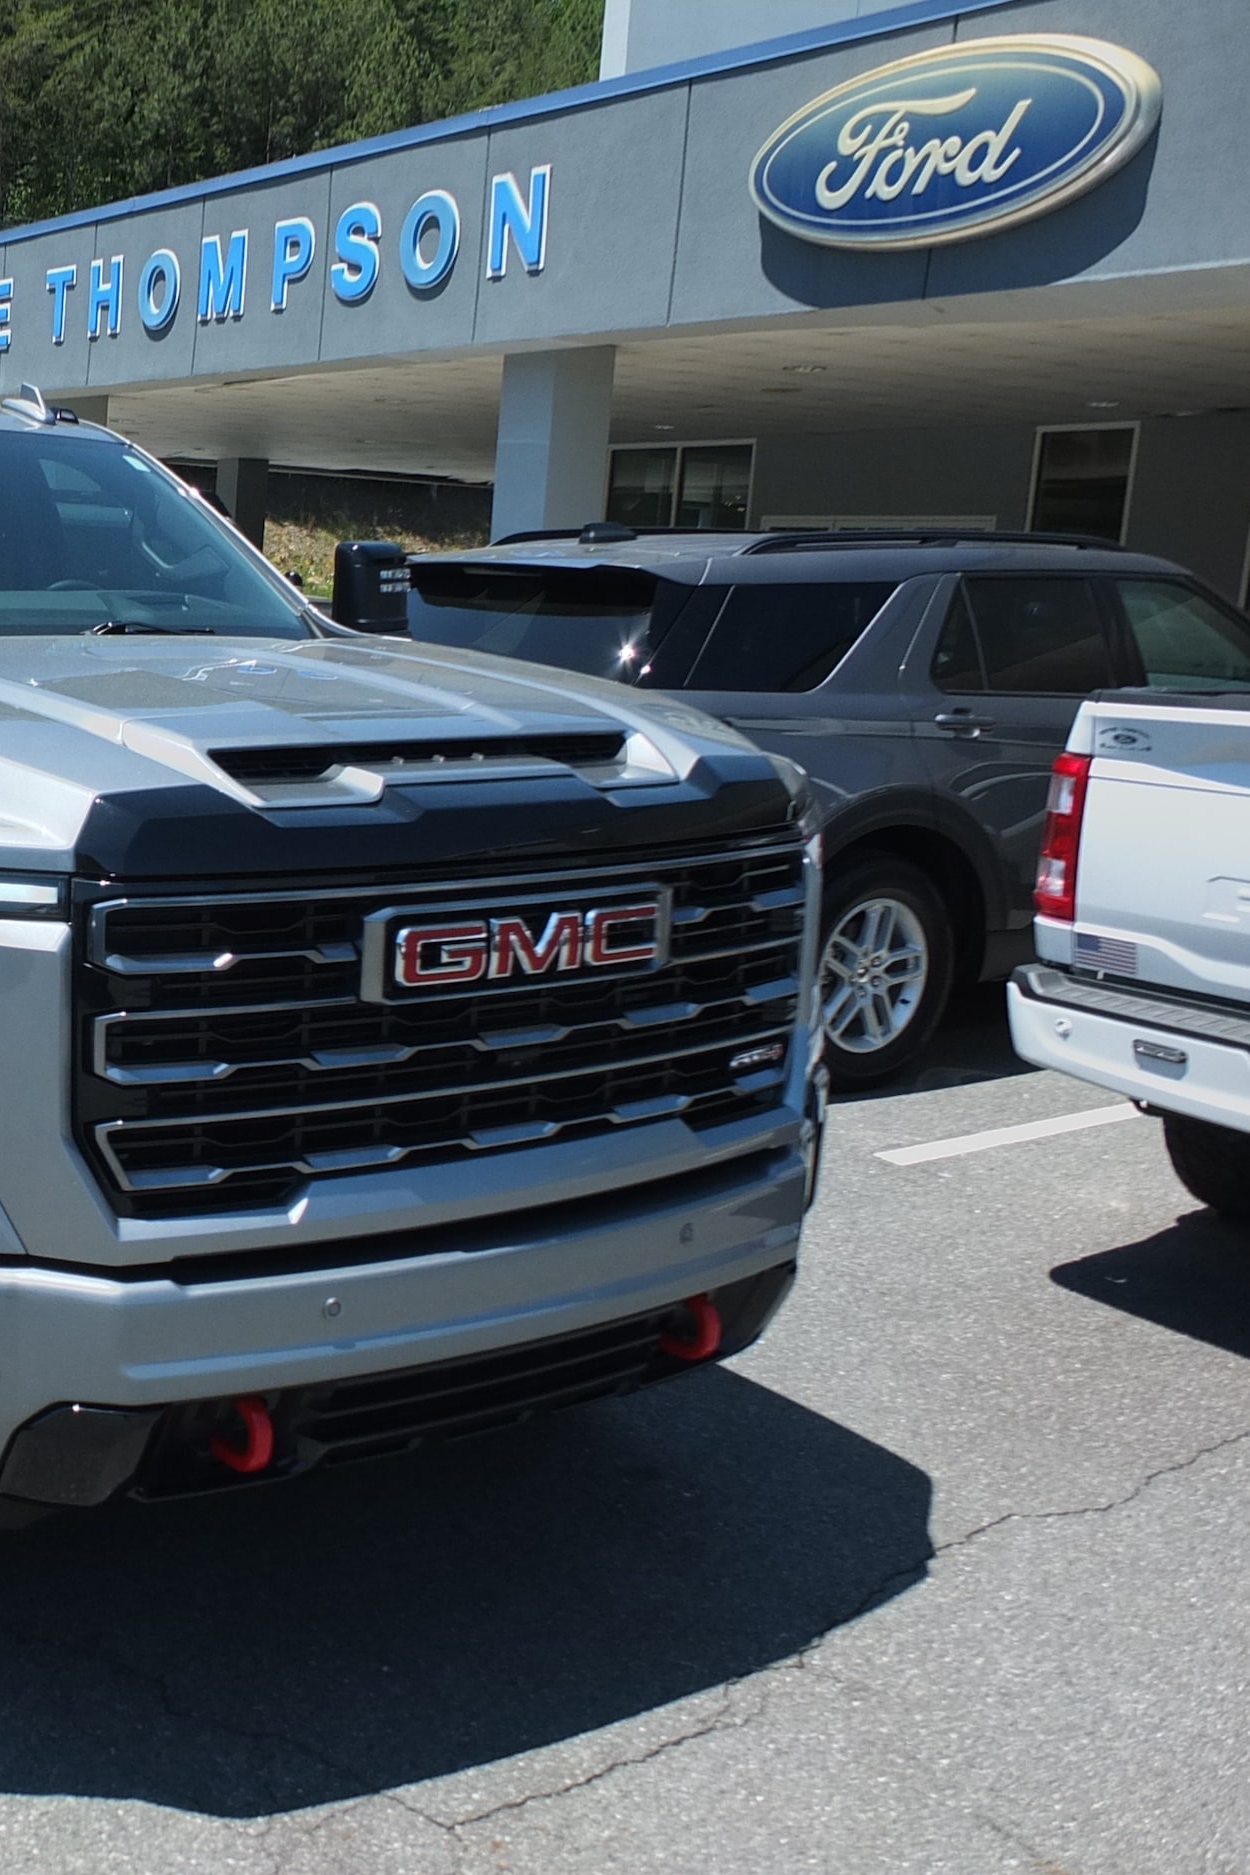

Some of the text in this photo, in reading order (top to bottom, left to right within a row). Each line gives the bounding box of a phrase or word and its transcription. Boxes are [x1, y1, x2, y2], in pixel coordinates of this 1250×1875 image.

[814, 87, 1033, 211] Ford
[45, 163, 553, 345] THOMPSON
[394, 903, 661, 988] GMC
